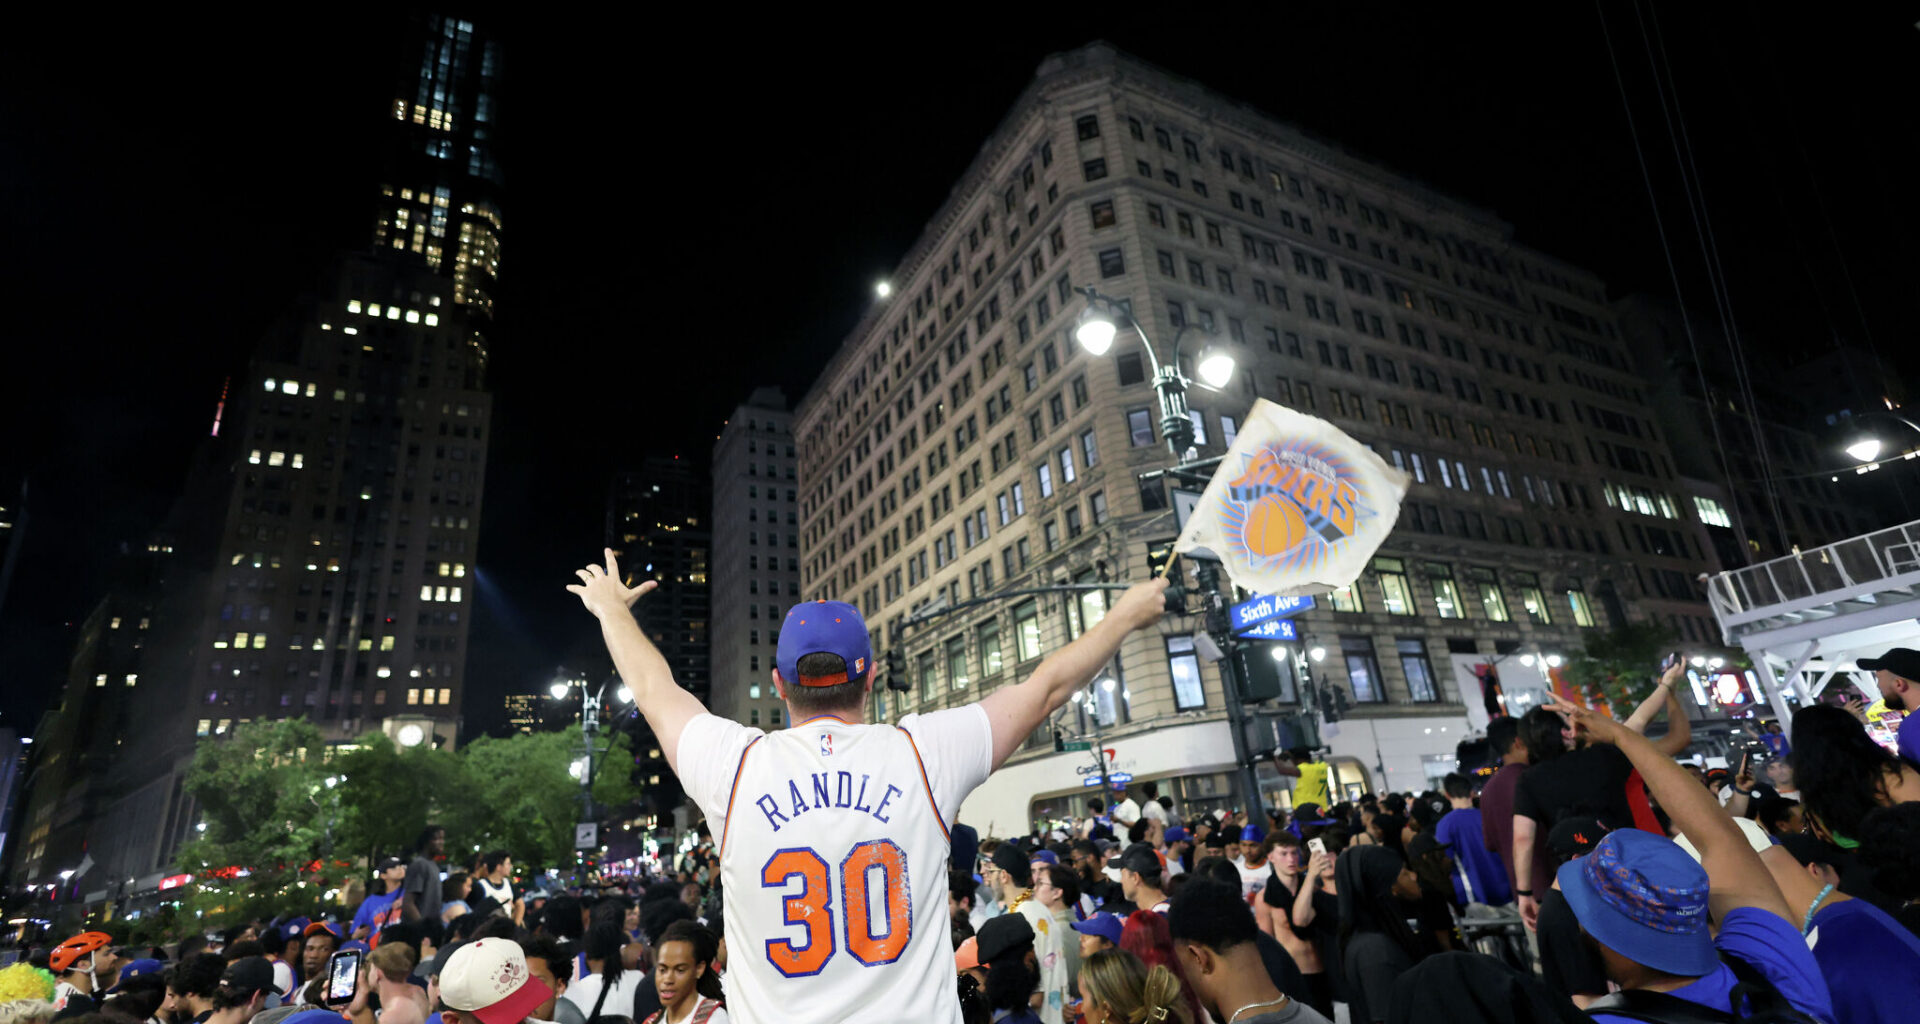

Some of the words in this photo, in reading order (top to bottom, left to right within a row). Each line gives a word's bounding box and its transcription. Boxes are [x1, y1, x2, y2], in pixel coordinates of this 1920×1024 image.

[1227, 447, 1358, 538] KNICKS
[1240, 600, 1273, 623] Sixth
[1274, 595, 1300, 613] Ave
[1281, 622, 1293, 637] St
[755, 770, 903, 832] RANDLE
[761, 837, 913, 978] 30
